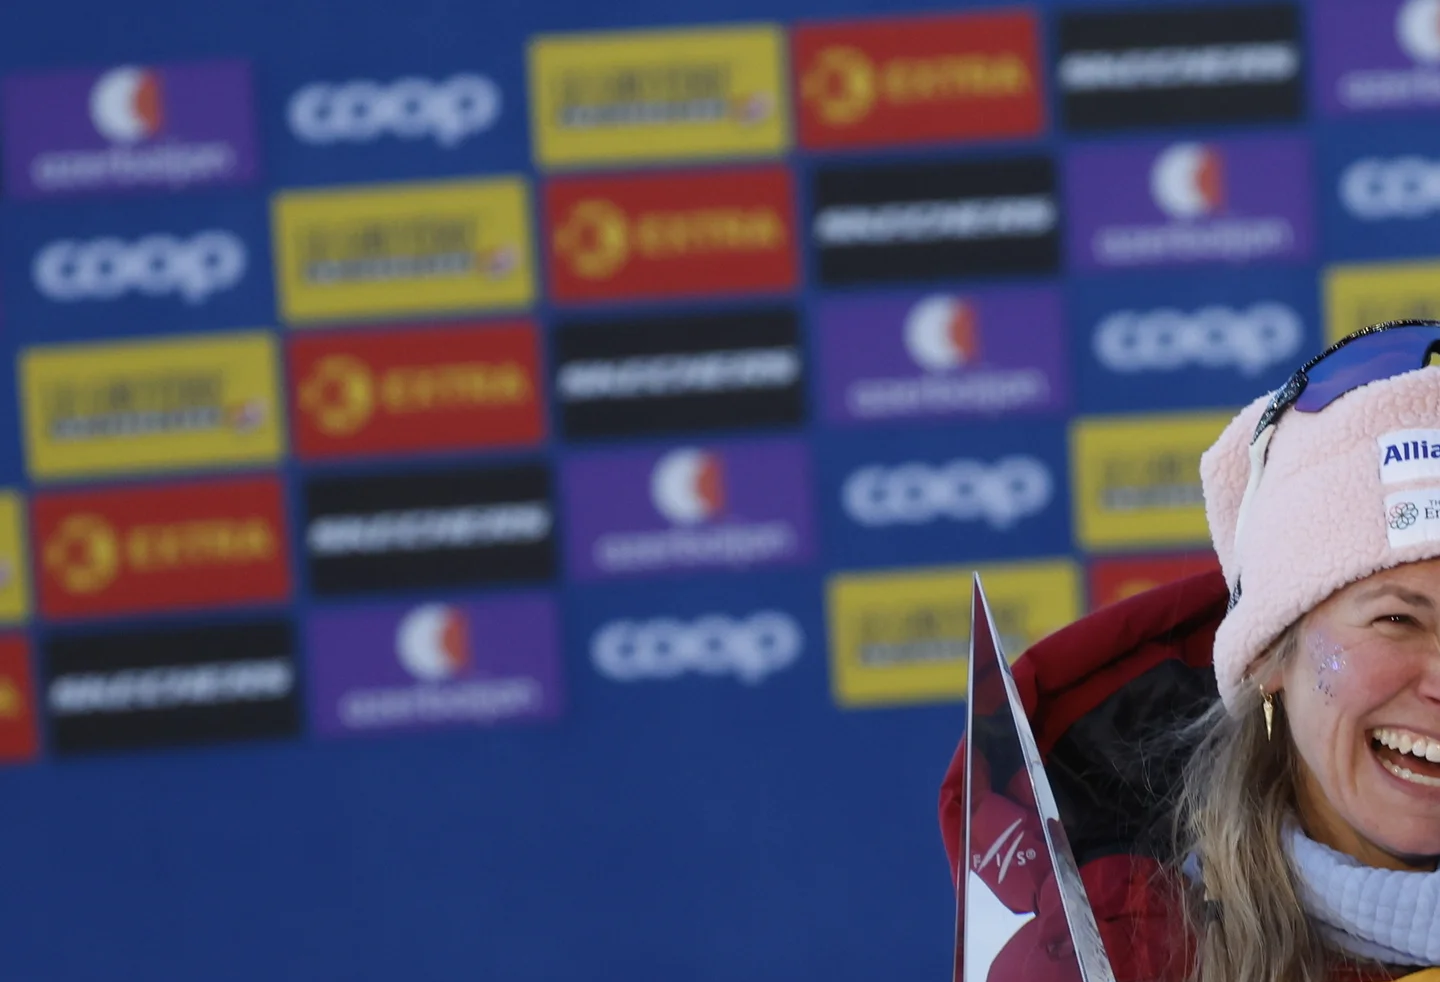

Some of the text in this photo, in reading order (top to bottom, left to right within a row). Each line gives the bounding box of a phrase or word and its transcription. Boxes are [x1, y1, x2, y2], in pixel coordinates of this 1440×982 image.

[289, 75, 499, 145] coop
[35, 232, 246, 301] coop
[1094, 304, 1302, 373] coop
[843, 457, 1051, 526] coop
[593, 612, 802, 681] coop
